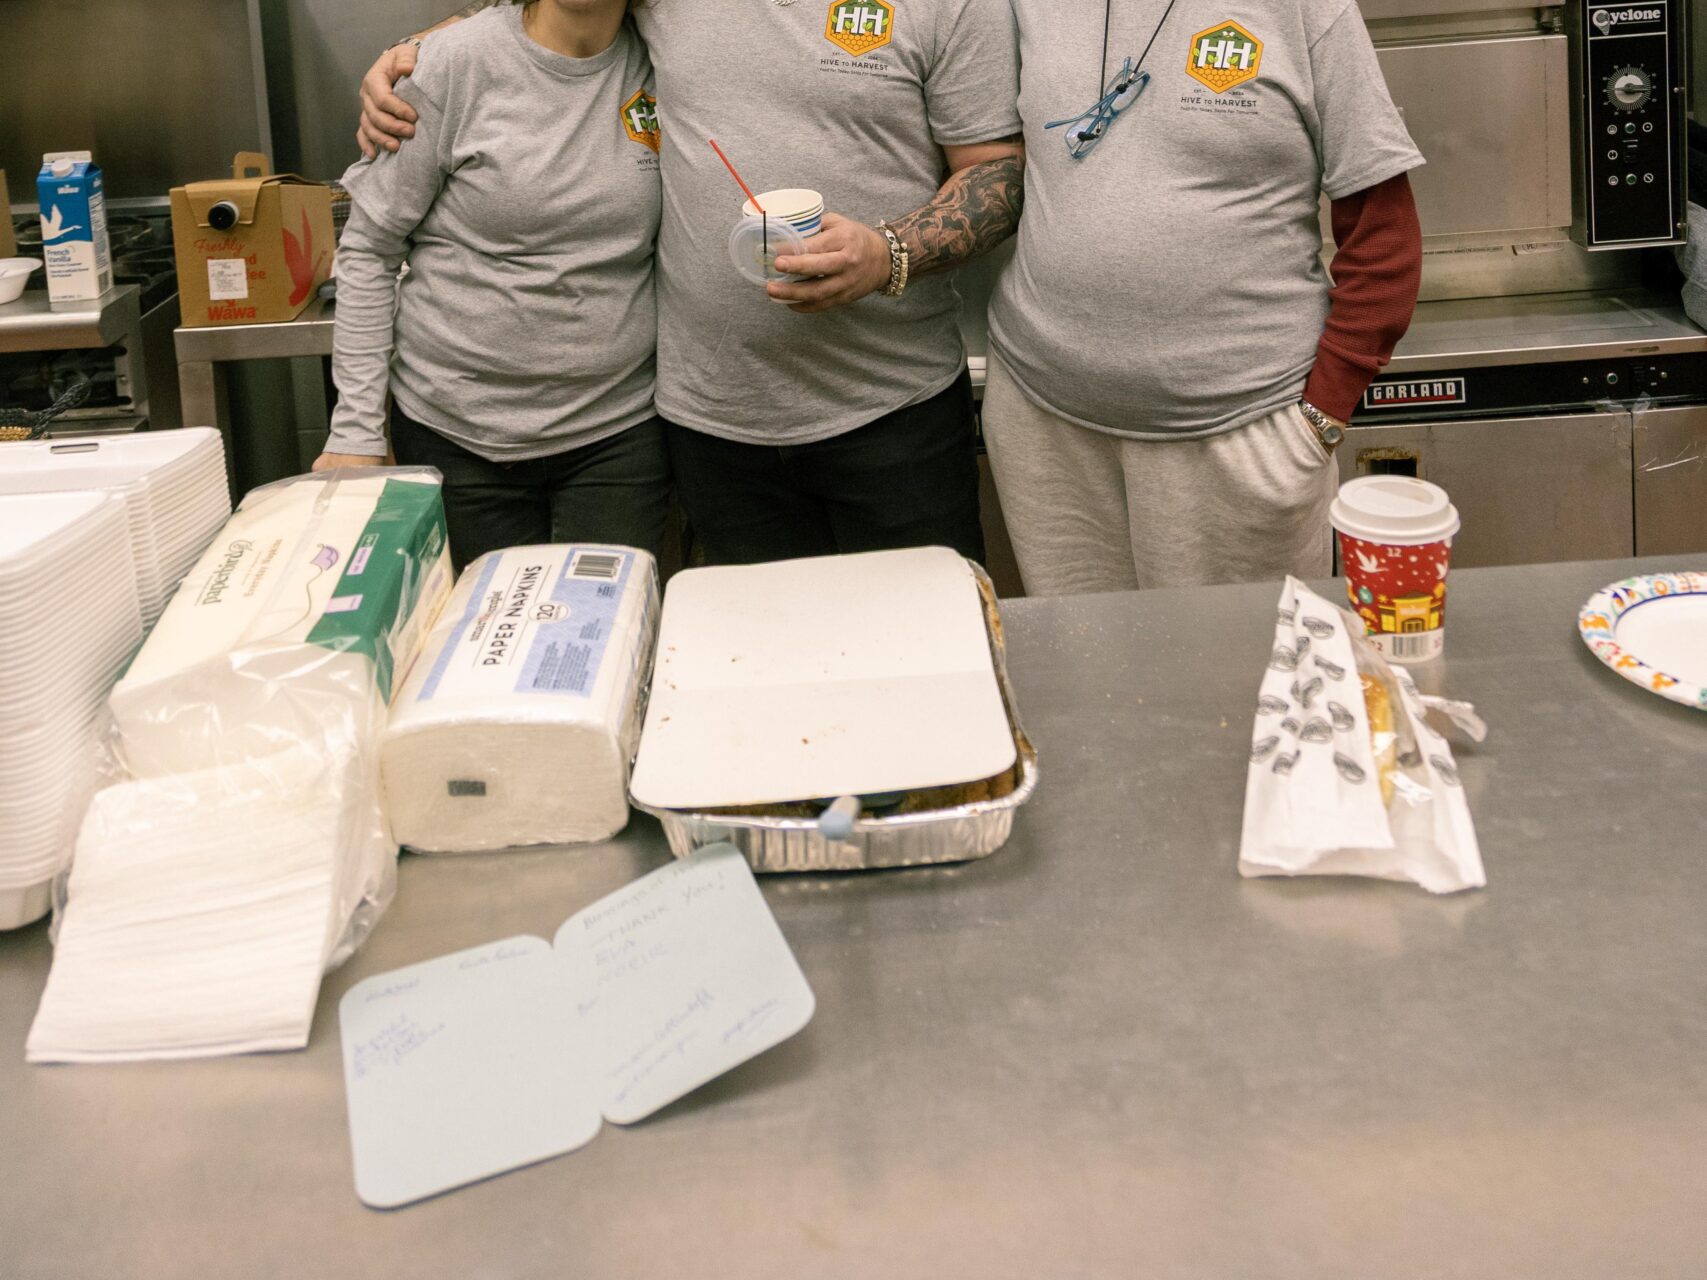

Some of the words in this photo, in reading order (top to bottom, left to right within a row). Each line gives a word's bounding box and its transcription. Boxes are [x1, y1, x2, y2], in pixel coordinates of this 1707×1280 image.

[835, 6, 884, 36] HH
[1592, 8, 1661, 26] Cyclone
[1197, 38, 1252, 70] HH
[820, 58, 840, 66] HIVE
[851, 61, 889, 71] HARVEST
[1180, 96, 1202, 104] HIVE
[1214, 98, 1257, 108] HARVEST
[193, 237, 246, 257] Freshly
[207, 306, 257, 321] Wawa
[1373, 381, 1456, 400] GARLAND
[1387, 546, 1402, 558] 12
[482, 622, 519, 666] PAPER
[504, 564, 543, 618] NAPKINS
[535, 603, 556, 621] 120
